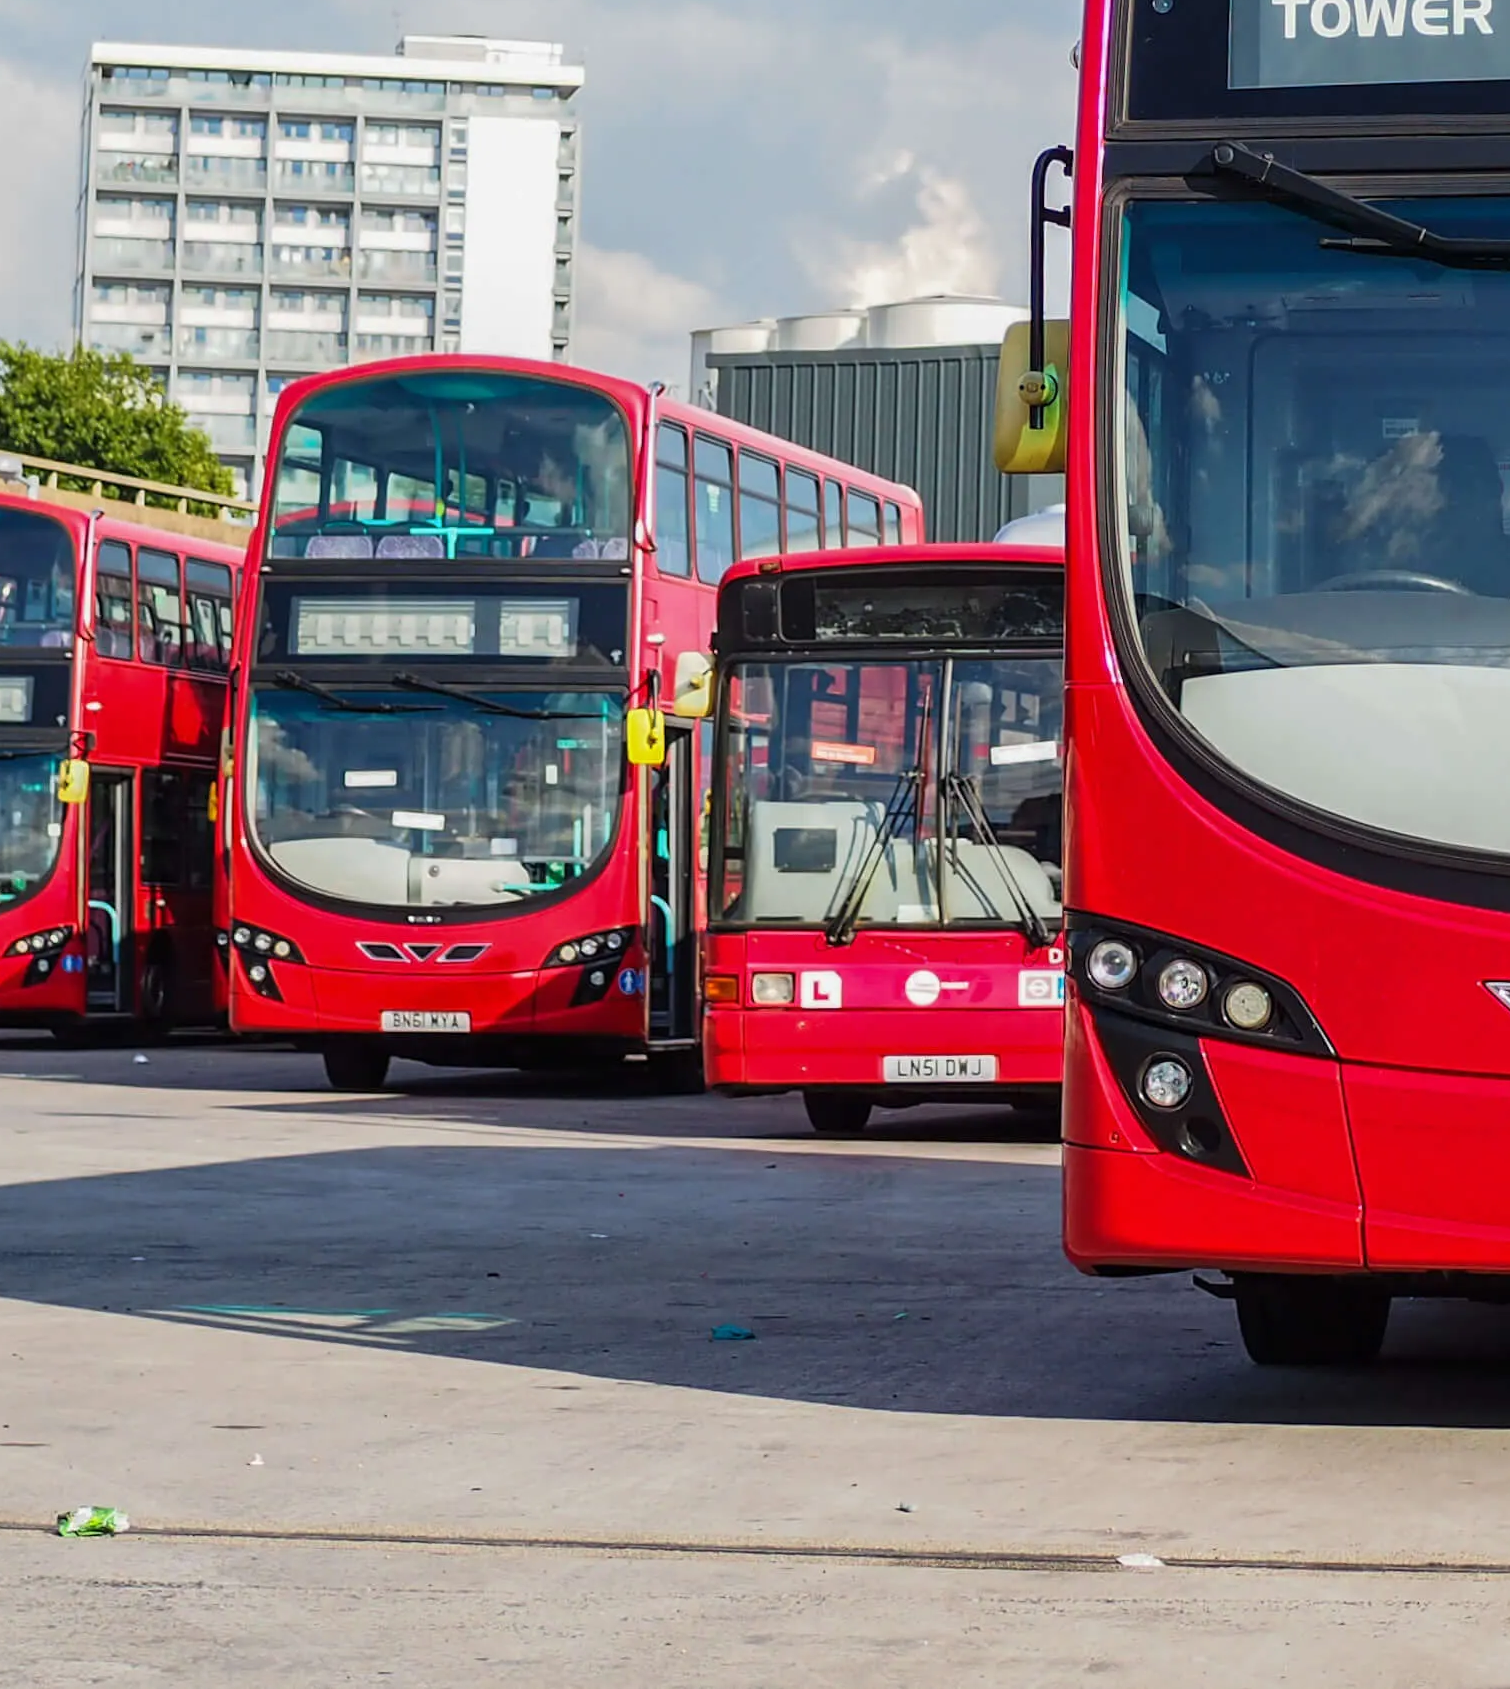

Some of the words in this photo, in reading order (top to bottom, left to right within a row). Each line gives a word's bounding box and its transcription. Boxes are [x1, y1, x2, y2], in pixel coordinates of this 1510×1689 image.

[813, 981, 829, 1001] L
[897, 1059, 939, 1077] LN51
[945, 1059, 982, 1076] DWJ
